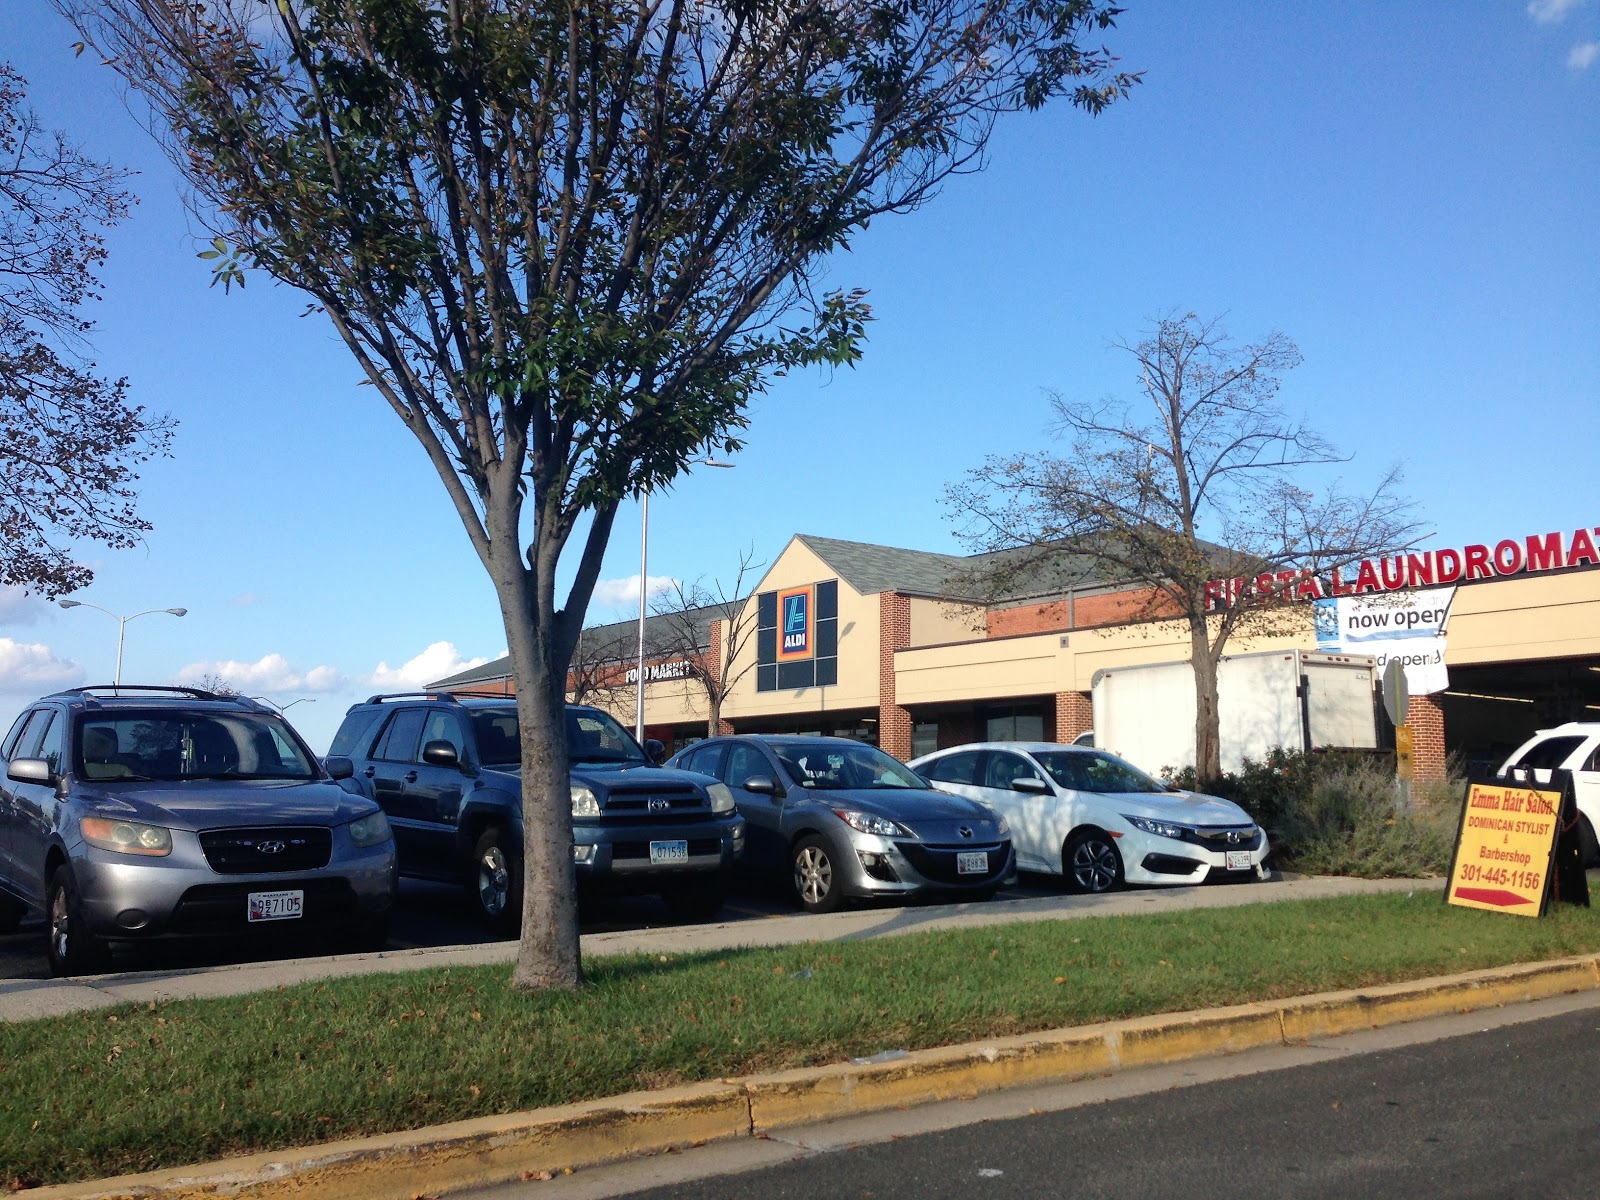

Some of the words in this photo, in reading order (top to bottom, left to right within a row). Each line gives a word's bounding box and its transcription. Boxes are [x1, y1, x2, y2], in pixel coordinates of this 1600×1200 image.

[1348, 612, 1390, 629] now
[1394, 608, 1445, 630] open
[784, 633, 806, 648] ALDI
[1471, 788, 1500, 810] Emma
[1502, 790, 1524, 812] Hair
[1526, 792, 1553, 815] Salon
[1469, 816, 1513, 832] DOMINICAN
[1516, 821, 1550, 836] STYLIST
[1503, 834, 1508, 844] &
[1479, 845, 1531, 867] Barbershop
[1460, 864, 1541, 890] 301-445-1156
